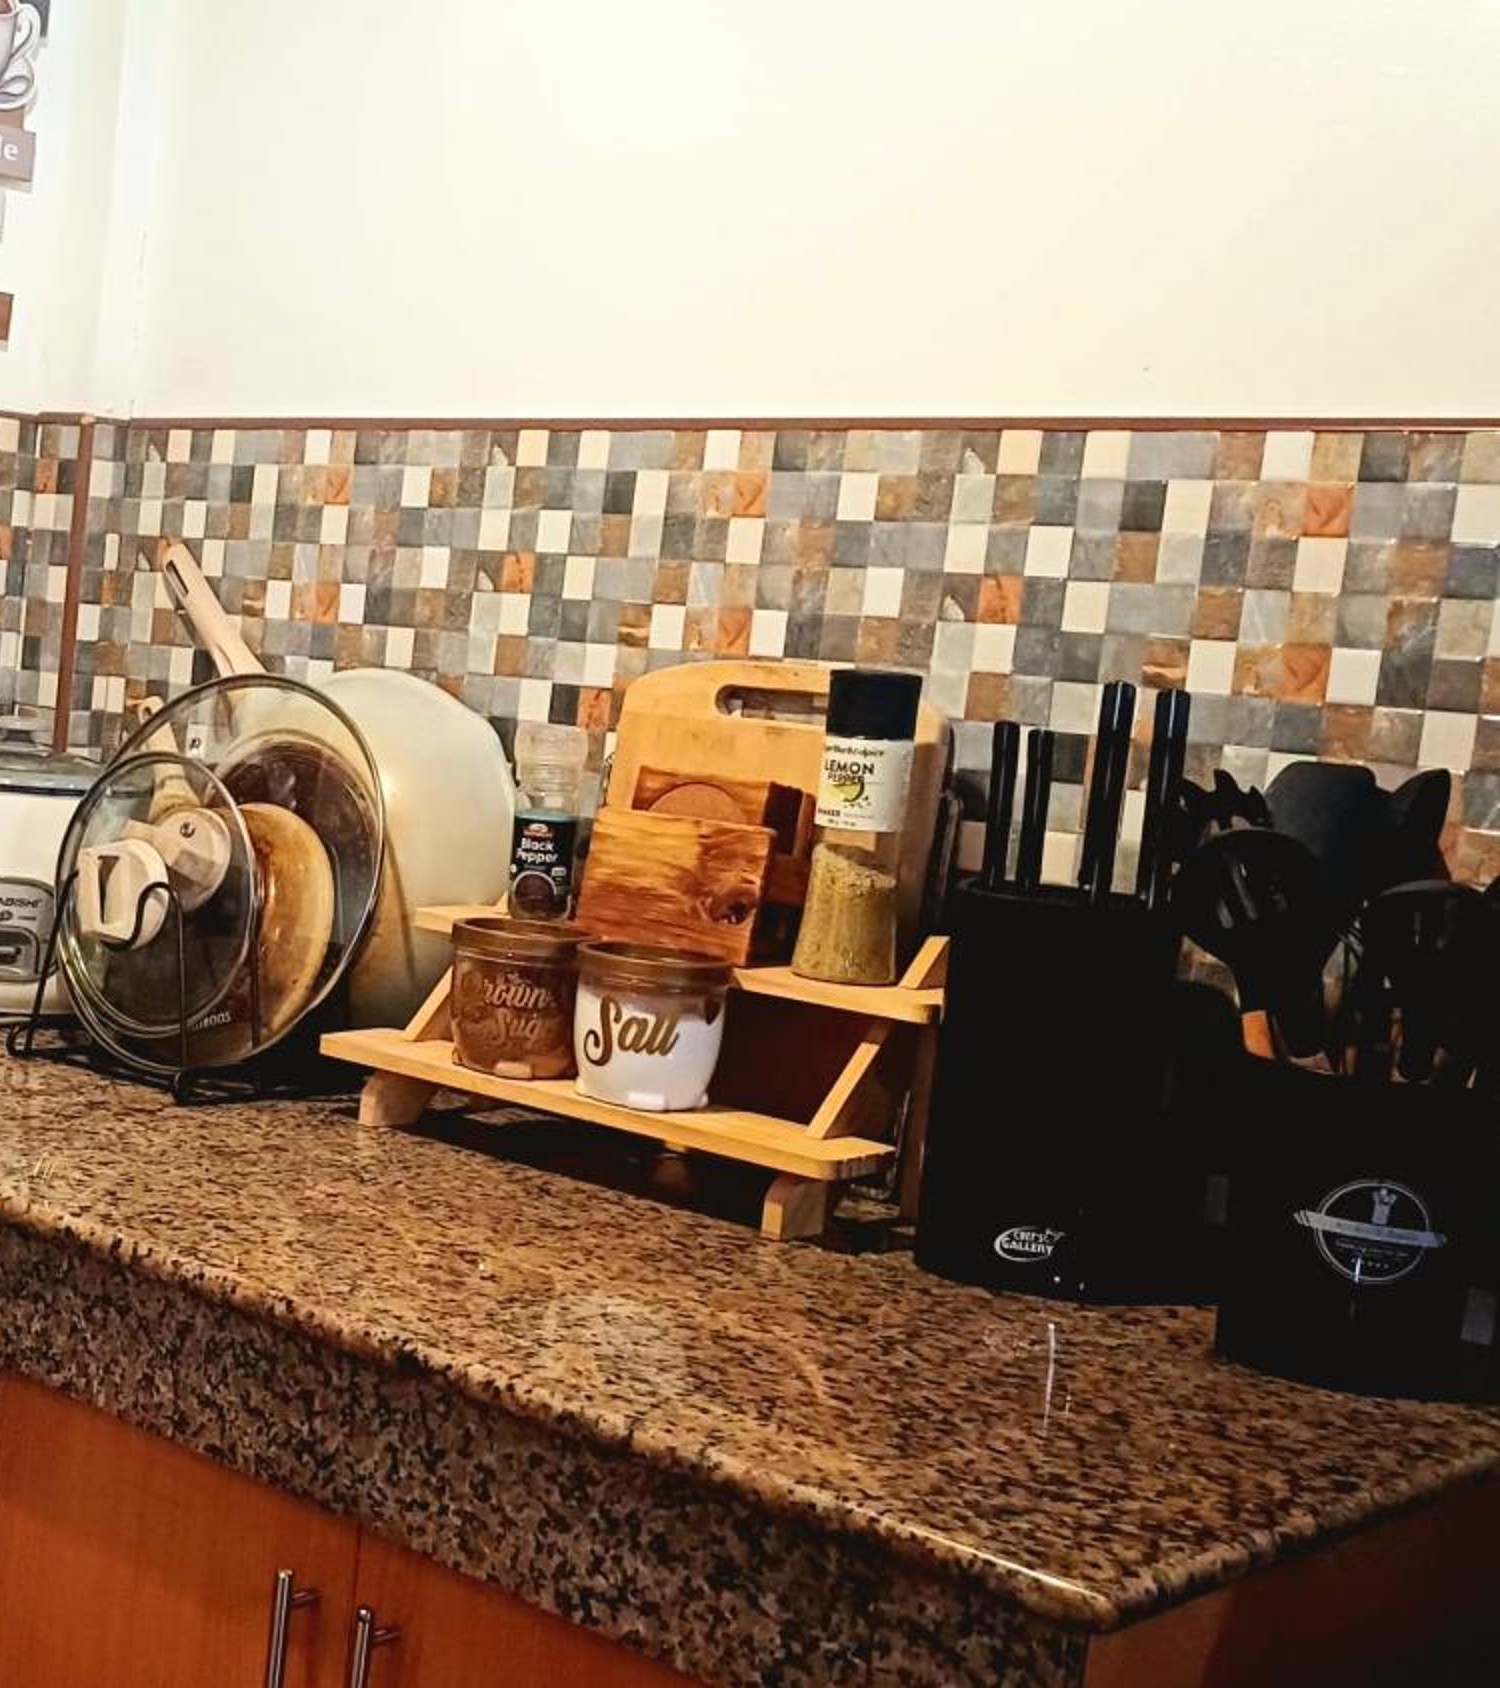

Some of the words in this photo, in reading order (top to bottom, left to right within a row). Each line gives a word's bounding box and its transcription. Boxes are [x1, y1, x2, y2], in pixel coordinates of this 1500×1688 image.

[825, 759, 874, 775] LEMON
[521, 837, 554, 851] Black
[516, 848, 558, 864] Pepper
